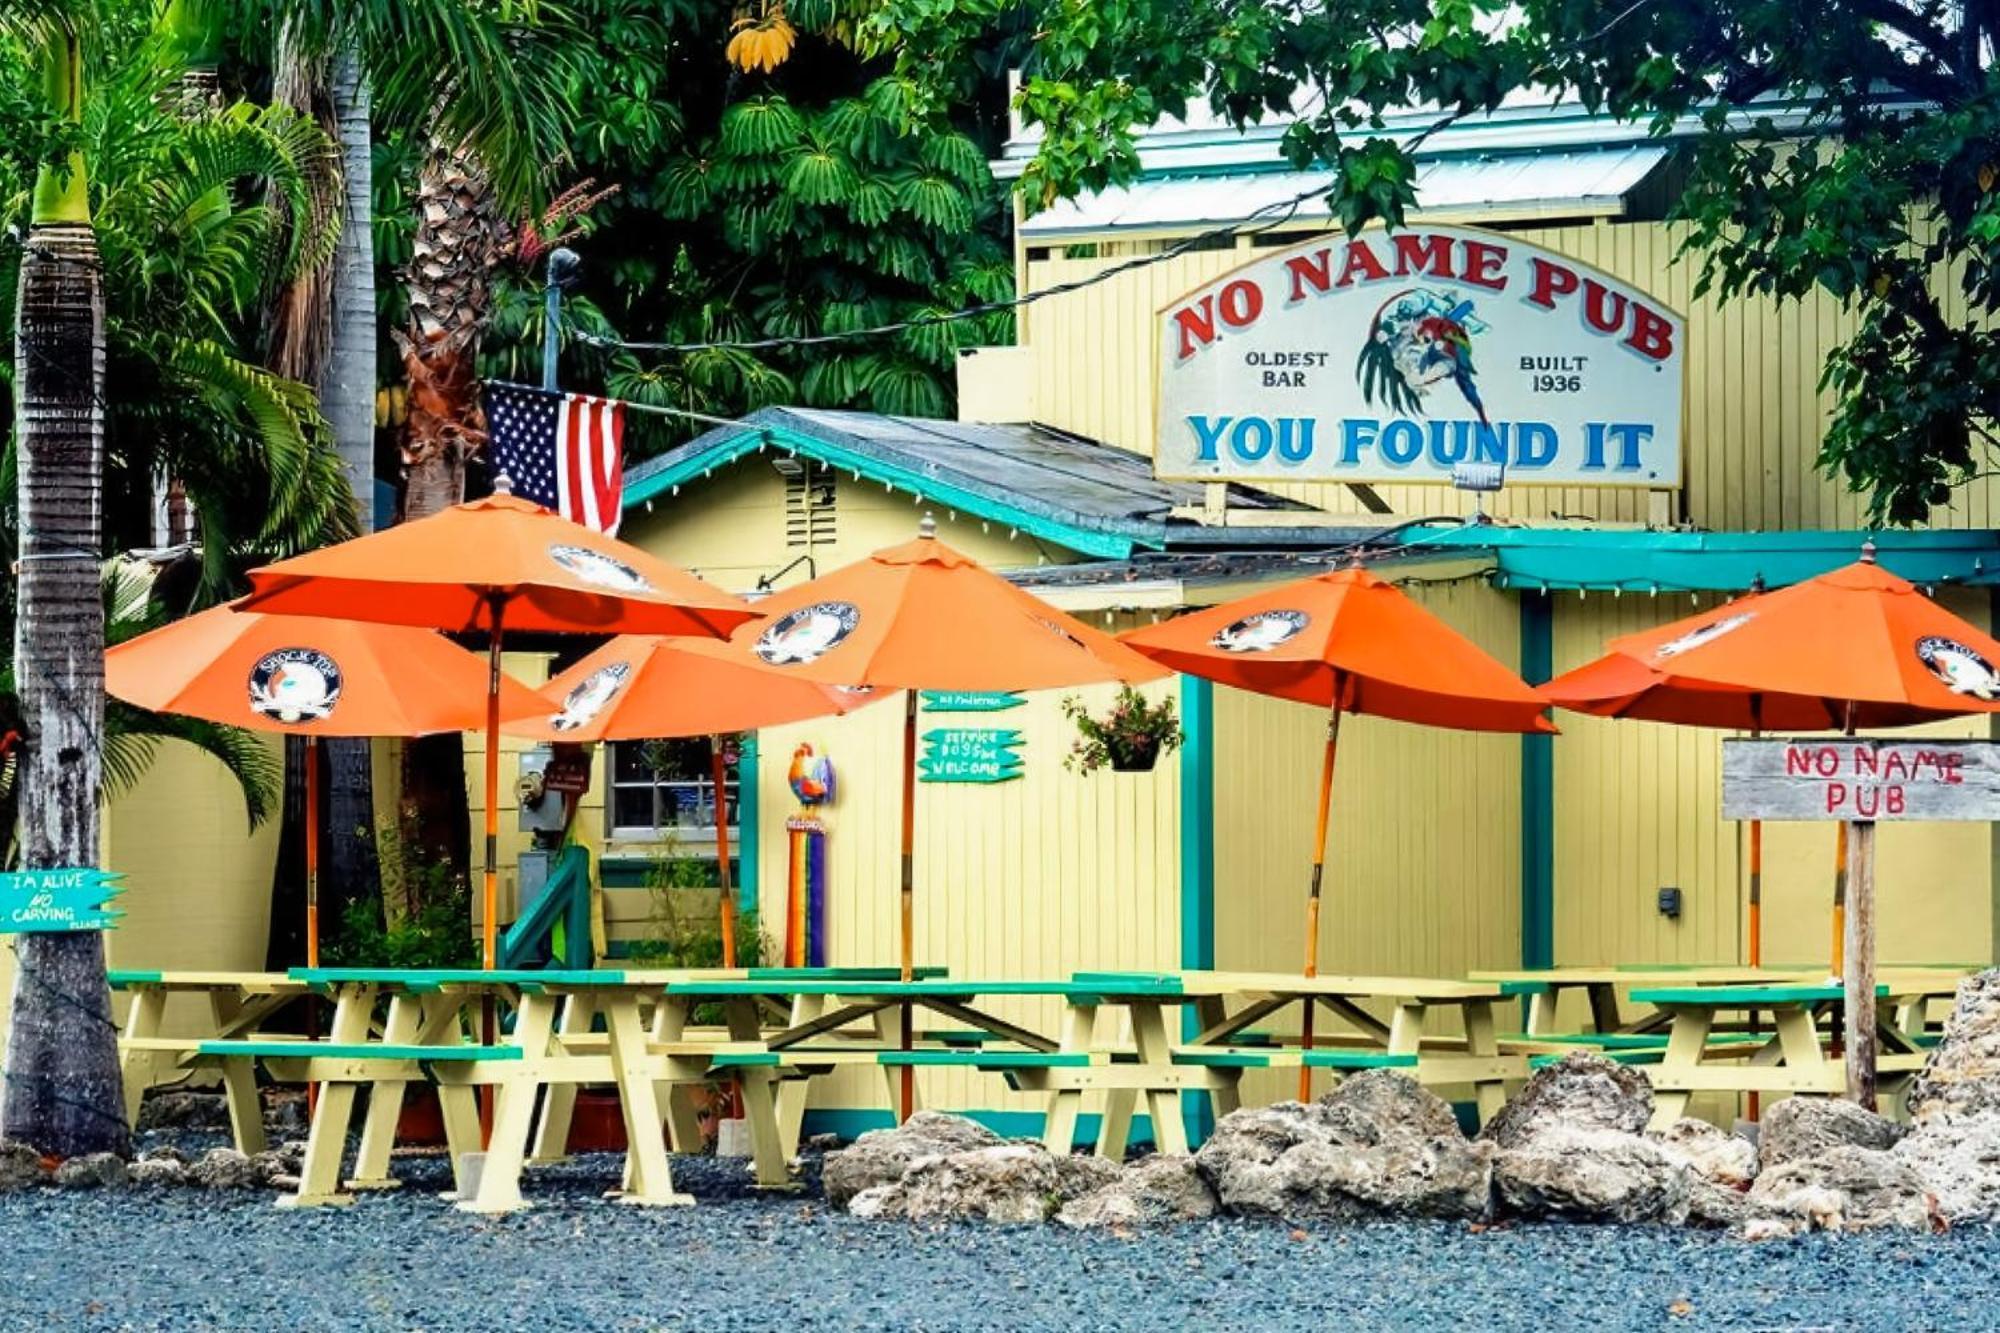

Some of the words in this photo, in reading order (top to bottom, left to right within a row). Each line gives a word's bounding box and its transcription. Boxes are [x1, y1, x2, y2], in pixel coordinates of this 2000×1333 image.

[1175, 279, 1265, 360] NO
[1285, 233, 1510, 303] NAME
[1526, 256, 1675, 363] PUB
[1245, 350, 1330, 368] OLDEST
[1519, 355, 1588, 373] BUILT
[1262, 370, 1307, 389] BAR
[1533, 374, 1582, 393] 1936
[1186, 415, 1317, 463] YOU
[1336, 418, 1560, 470] FOUND
[1584, 422, 1655, 470] IT
[1786, 746, 1840, 777] NO
[1854, 746, 1964, 785] NAME
[1827, 783, 1906, 818] PUB
[41, 870, 86, 889] ALIVE
[11, 906, 76, 924] CARVING
